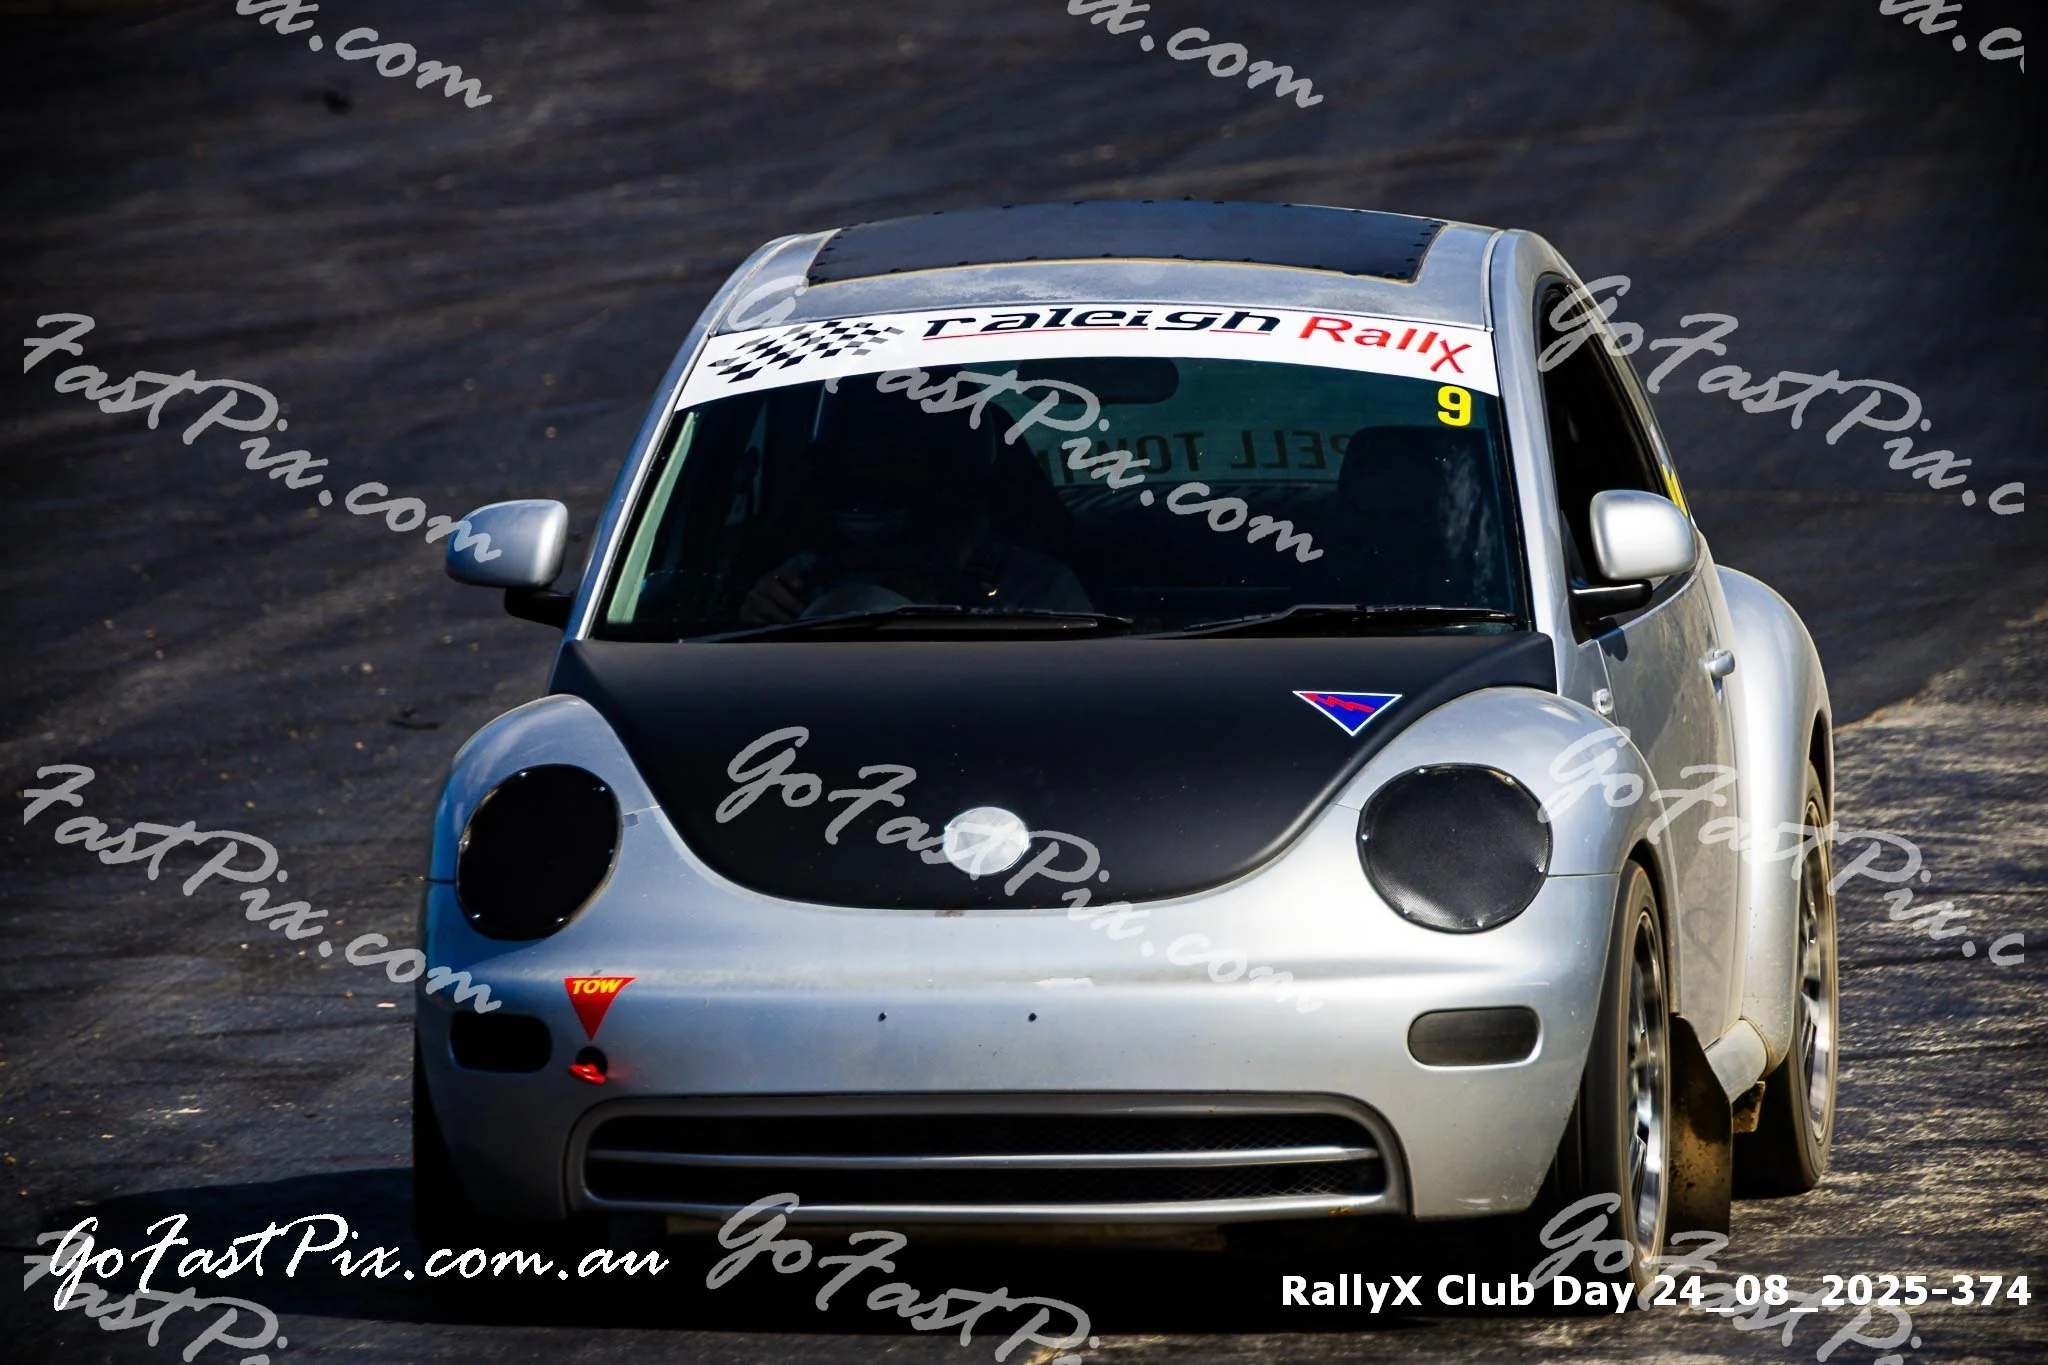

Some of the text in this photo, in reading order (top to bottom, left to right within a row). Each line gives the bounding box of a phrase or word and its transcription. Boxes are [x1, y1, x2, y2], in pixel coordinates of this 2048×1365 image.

[922, 307, 1281, 338] raleigh
[1437, 385, 1472, 427] 9
[572, 978, 625, 995] TOW
